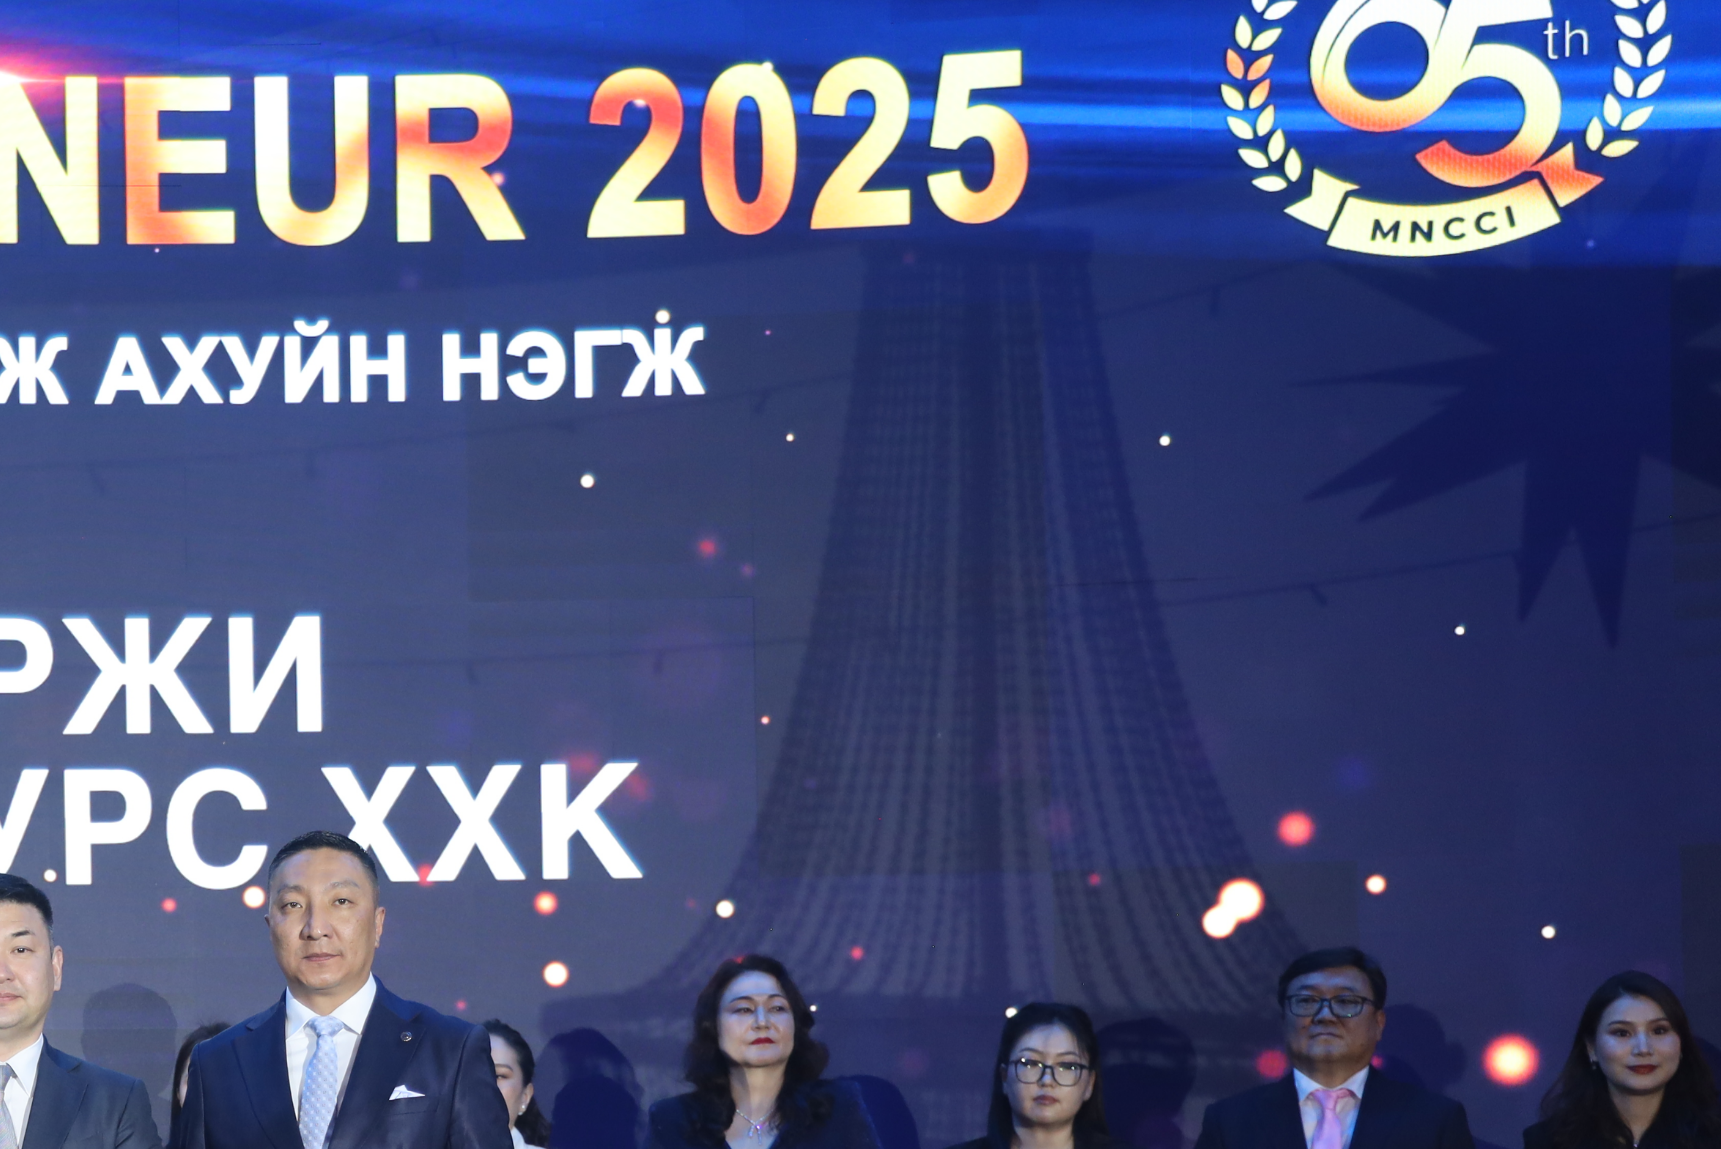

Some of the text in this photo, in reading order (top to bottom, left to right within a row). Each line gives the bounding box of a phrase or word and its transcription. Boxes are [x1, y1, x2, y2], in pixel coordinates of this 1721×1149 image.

[587, 50, 1028, 238] 2025
[1370, 206, 1516, 243] MNCCI
[94, 319, 406, 405] АХУЙН
[442, 326, 706, 402] НЭГЖ
[321, 762, 643, 882] ХХК
